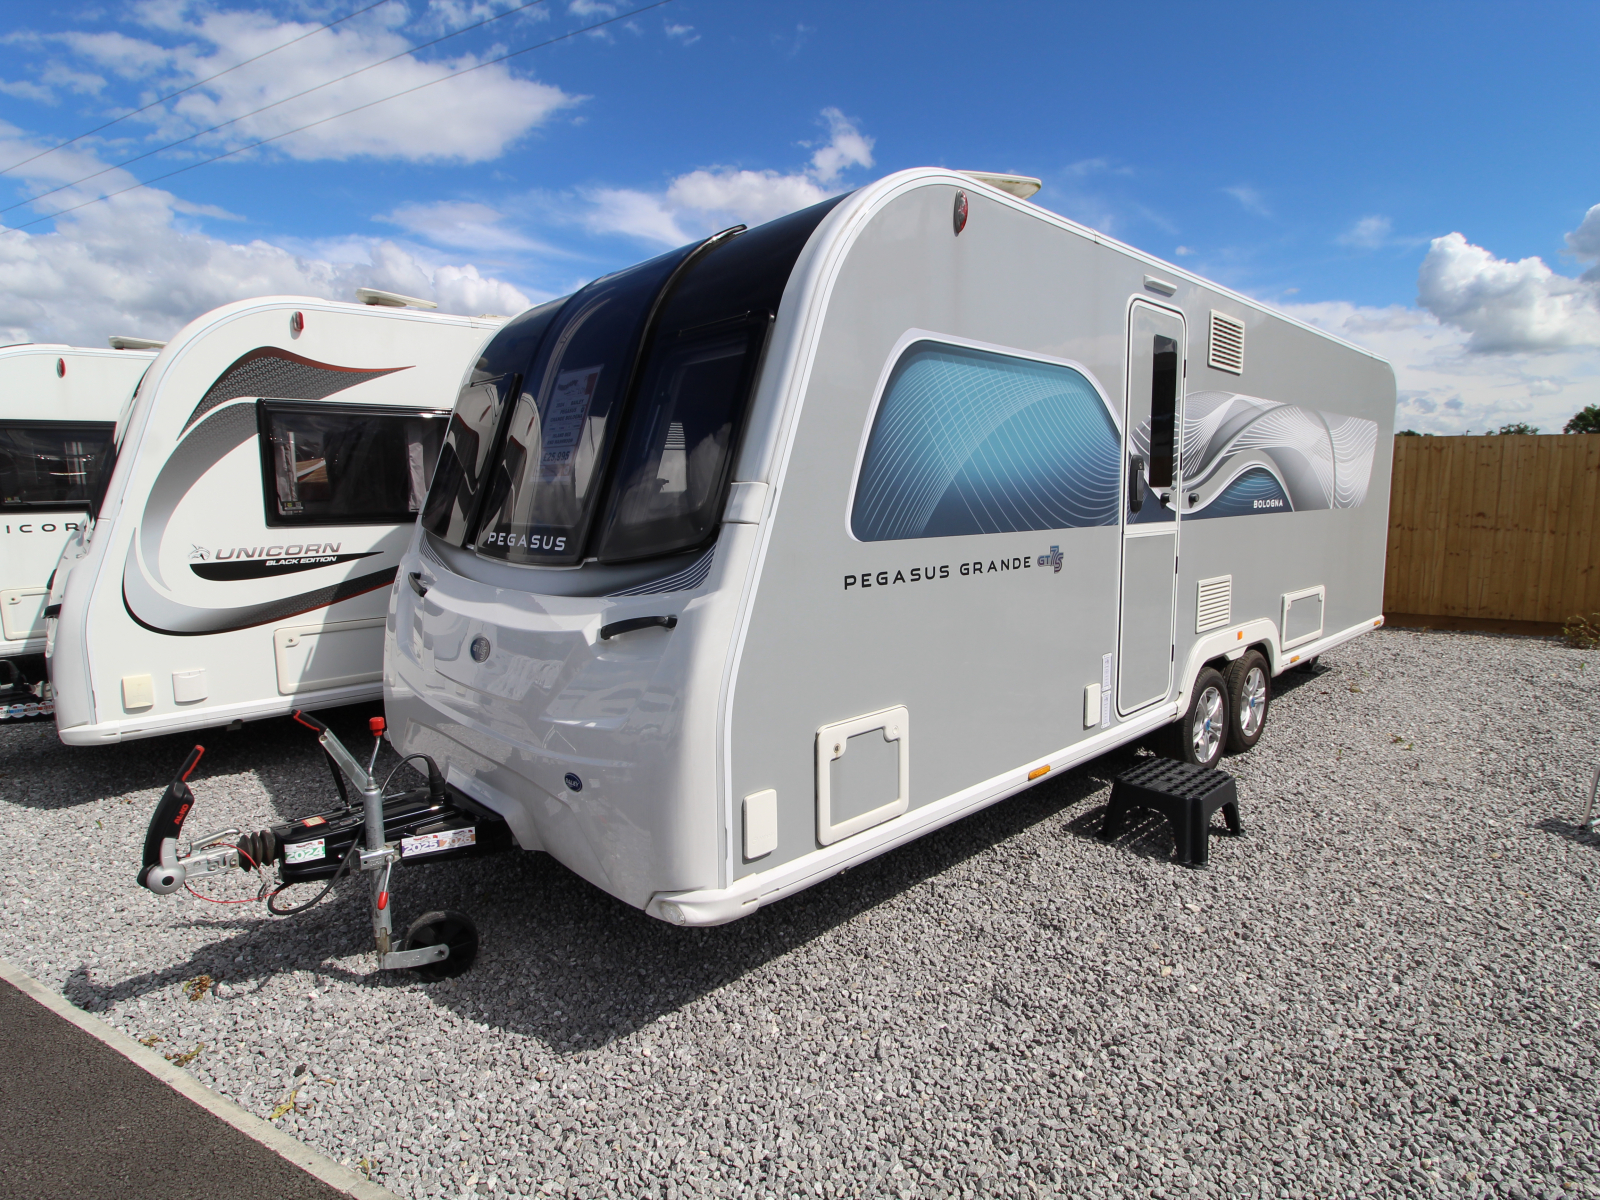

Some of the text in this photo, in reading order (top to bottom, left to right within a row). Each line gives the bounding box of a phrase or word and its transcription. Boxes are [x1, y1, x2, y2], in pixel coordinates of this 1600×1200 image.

[1253, 499, 1284, 509] BOLOGNA
[487, 532, 567, 551] PEGASUS
[215, 542, 342, 561] UNICORN
[265, 556, 337, 566] BLACK EDITION
[844, 564, 950, 590] PEGASUS
[959, 556, 1032, 576] GRANDE
[403, 835, 472, 853] 2025 2026
[286, 847, 323, 861] 2024
